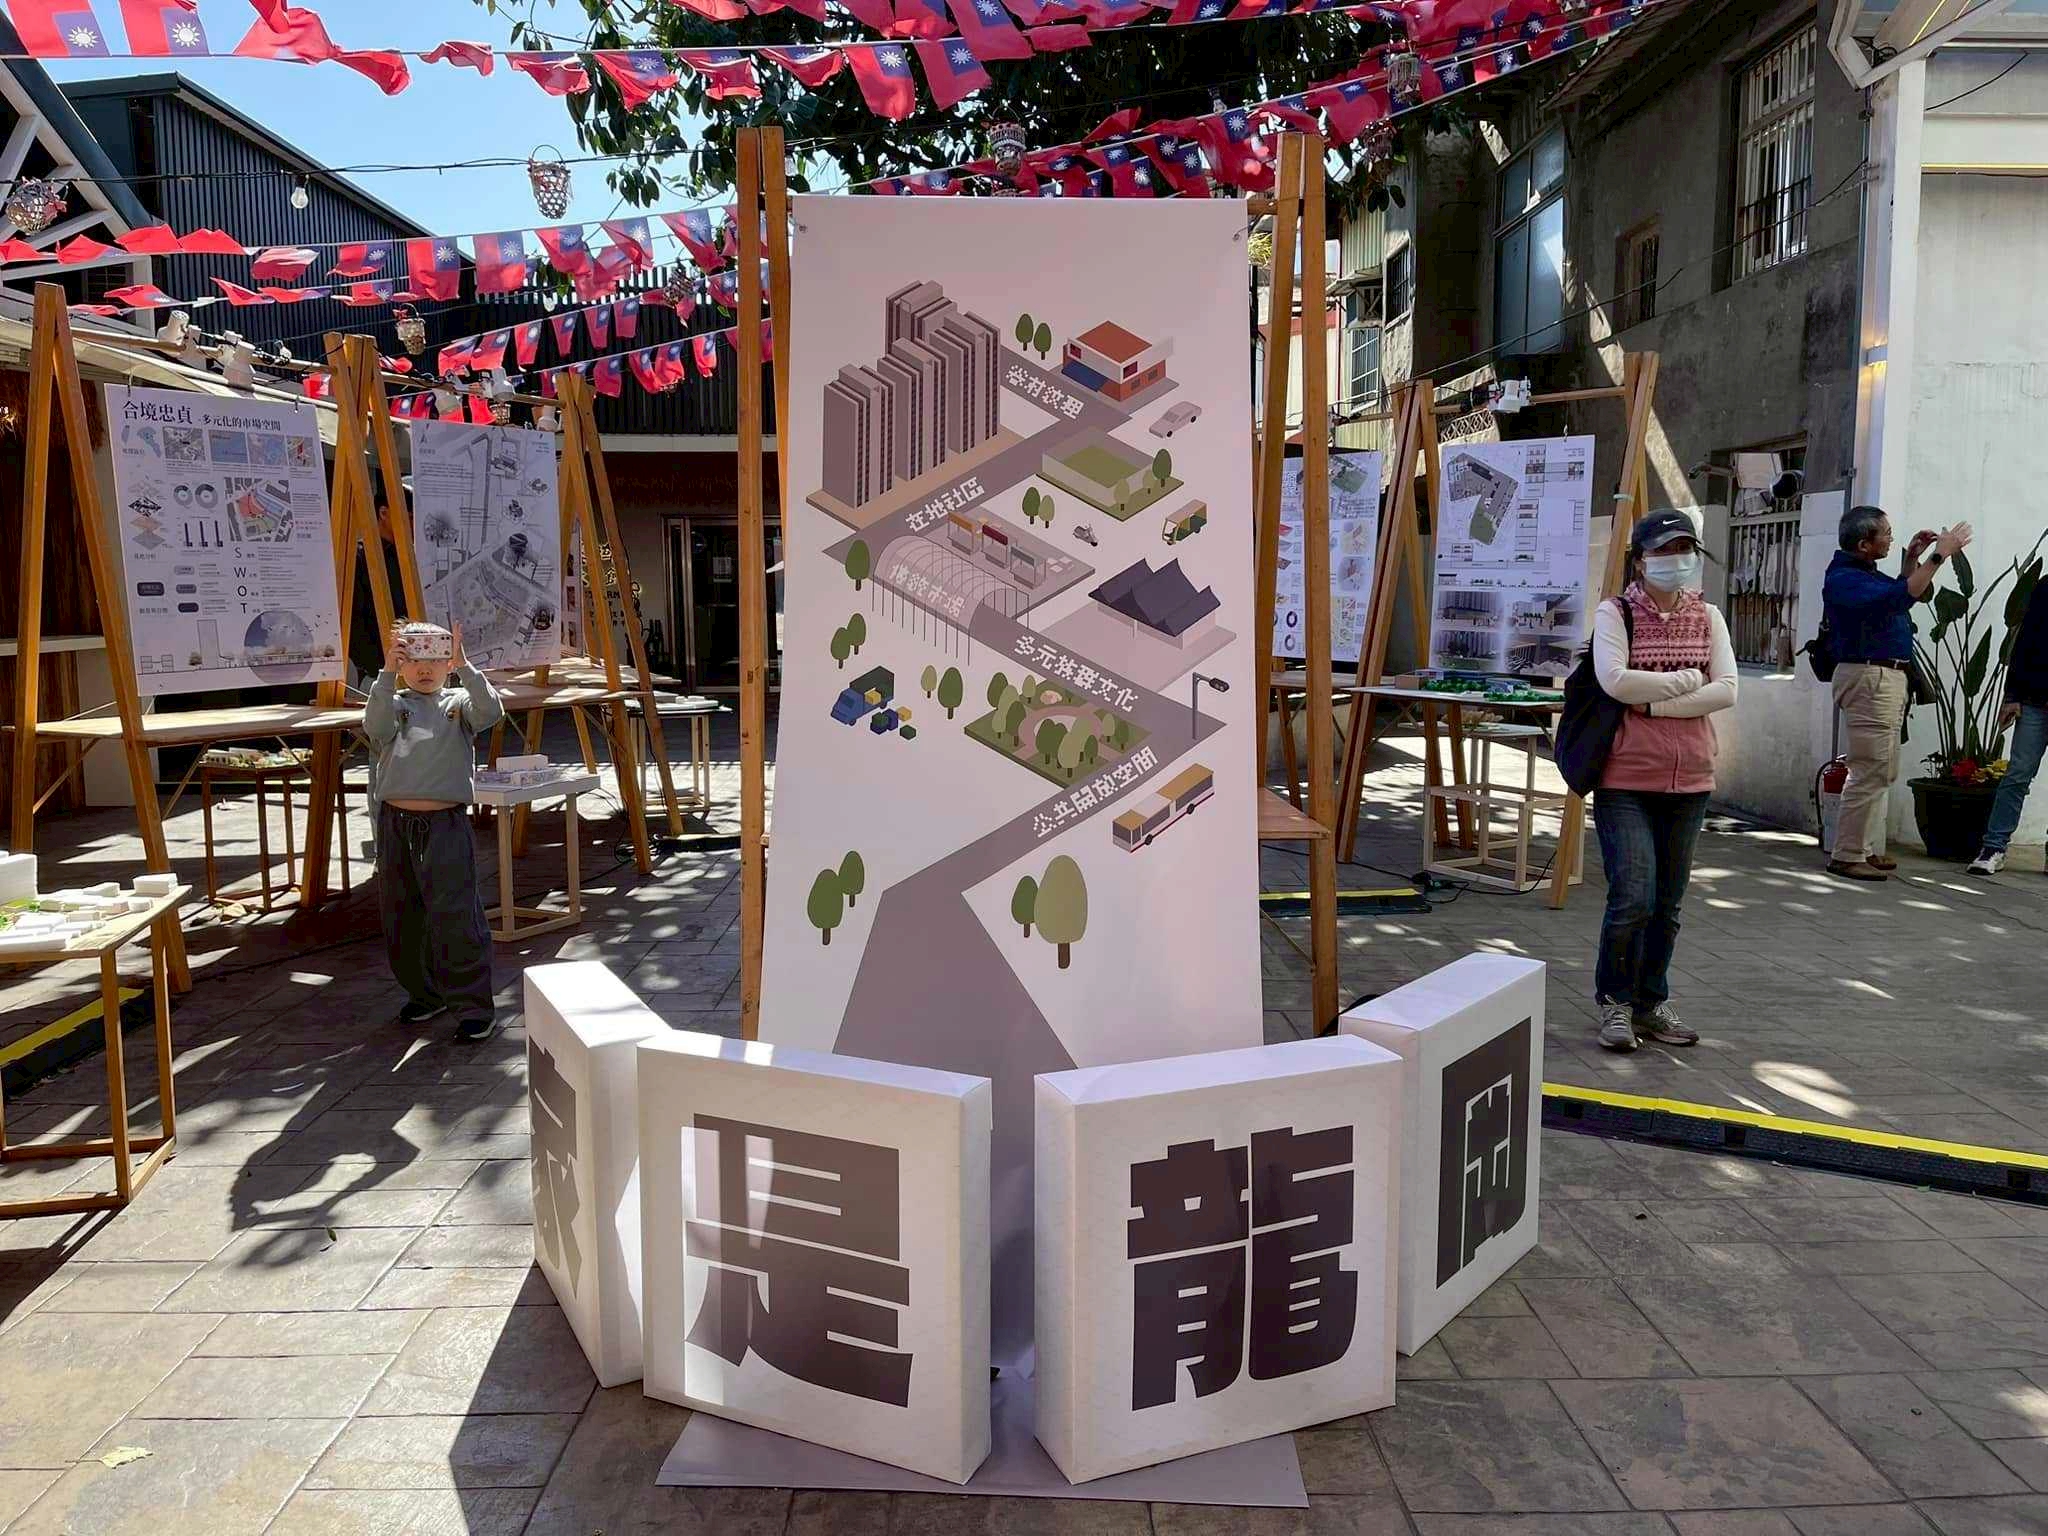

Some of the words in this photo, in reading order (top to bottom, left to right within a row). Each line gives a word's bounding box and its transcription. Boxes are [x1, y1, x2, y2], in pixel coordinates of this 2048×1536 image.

[122, 400, 193, 425] 合境忠貞
[905, 476, 985, 532] 在地社區
[234, 547, 243, 559] S
[233, 567, 247, 579] W
[237, 585, 248, 597] O
[240, 602, 248, 614] T
[1014, 635, 1139, 712] 多元族群文化
[1033, 745, 1159, 838] 公共開放空間
[684, 1112, 914, 1409] 是
[1127, 1125, 1358, 1411] 龍
[1435, 1015, 1532, 1290] 岡
